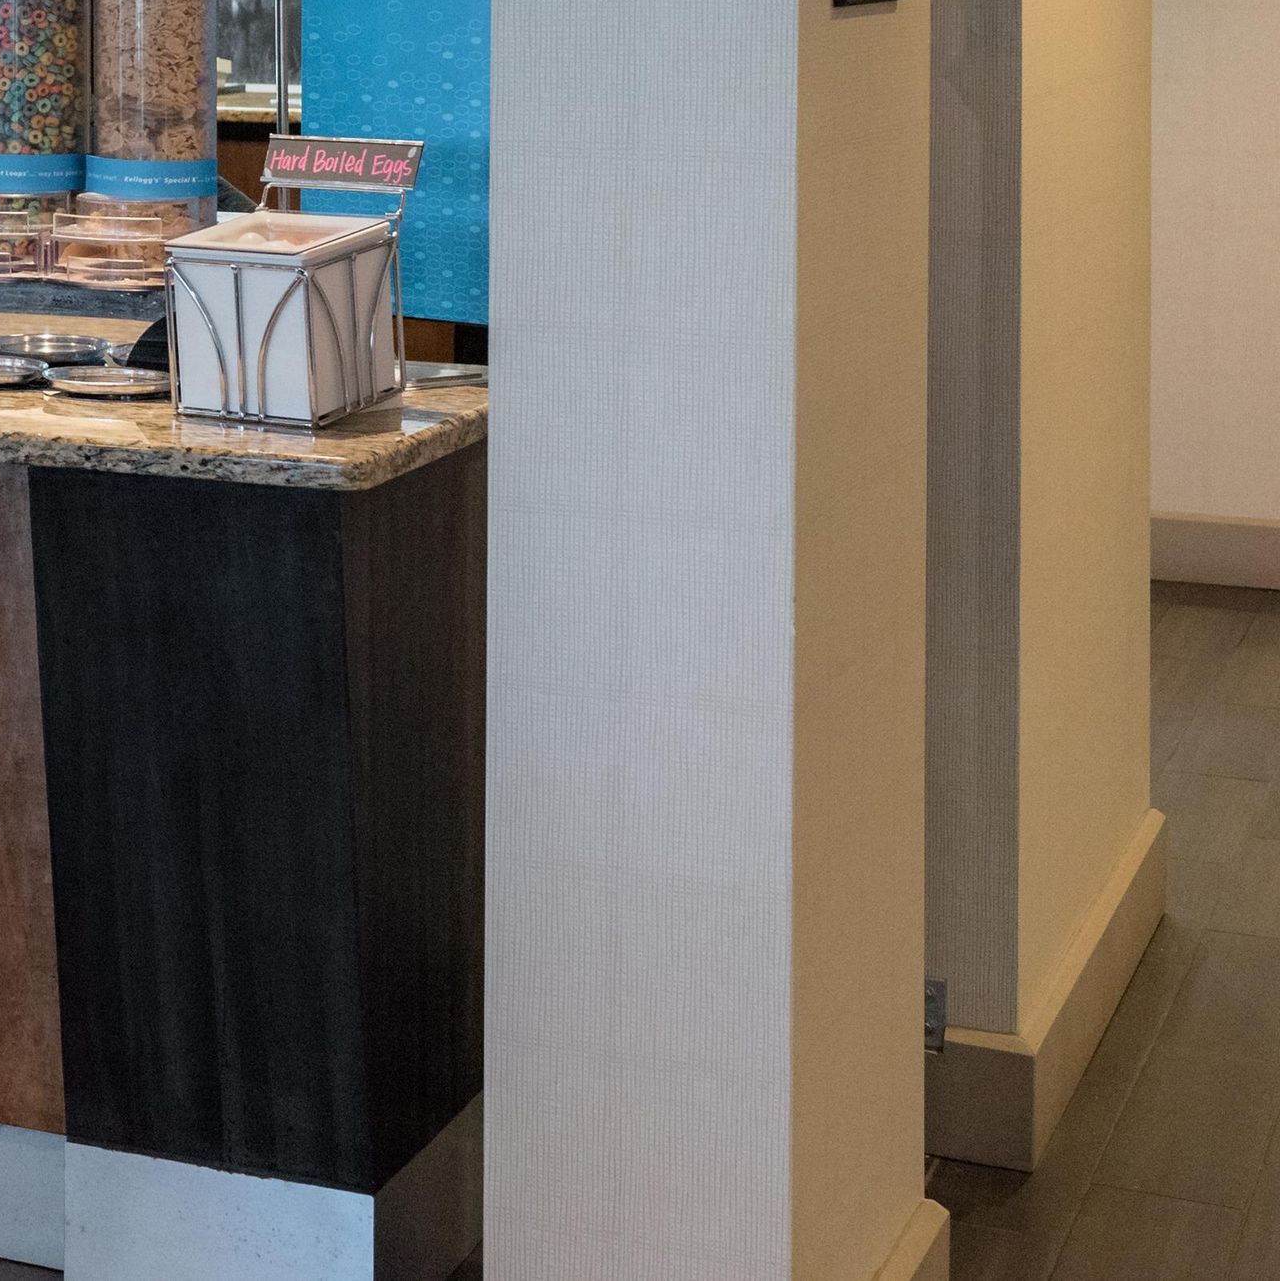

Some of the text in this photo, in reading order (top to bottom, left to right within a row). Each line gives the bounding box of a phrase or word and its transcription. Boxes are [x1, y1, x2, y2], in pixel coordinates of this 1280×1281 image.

[270, 145, 413, 184] Hard Boiled Eggs
[123, 175, 159, 184] Kellogg's
[164, 176, 190, 185] Special
